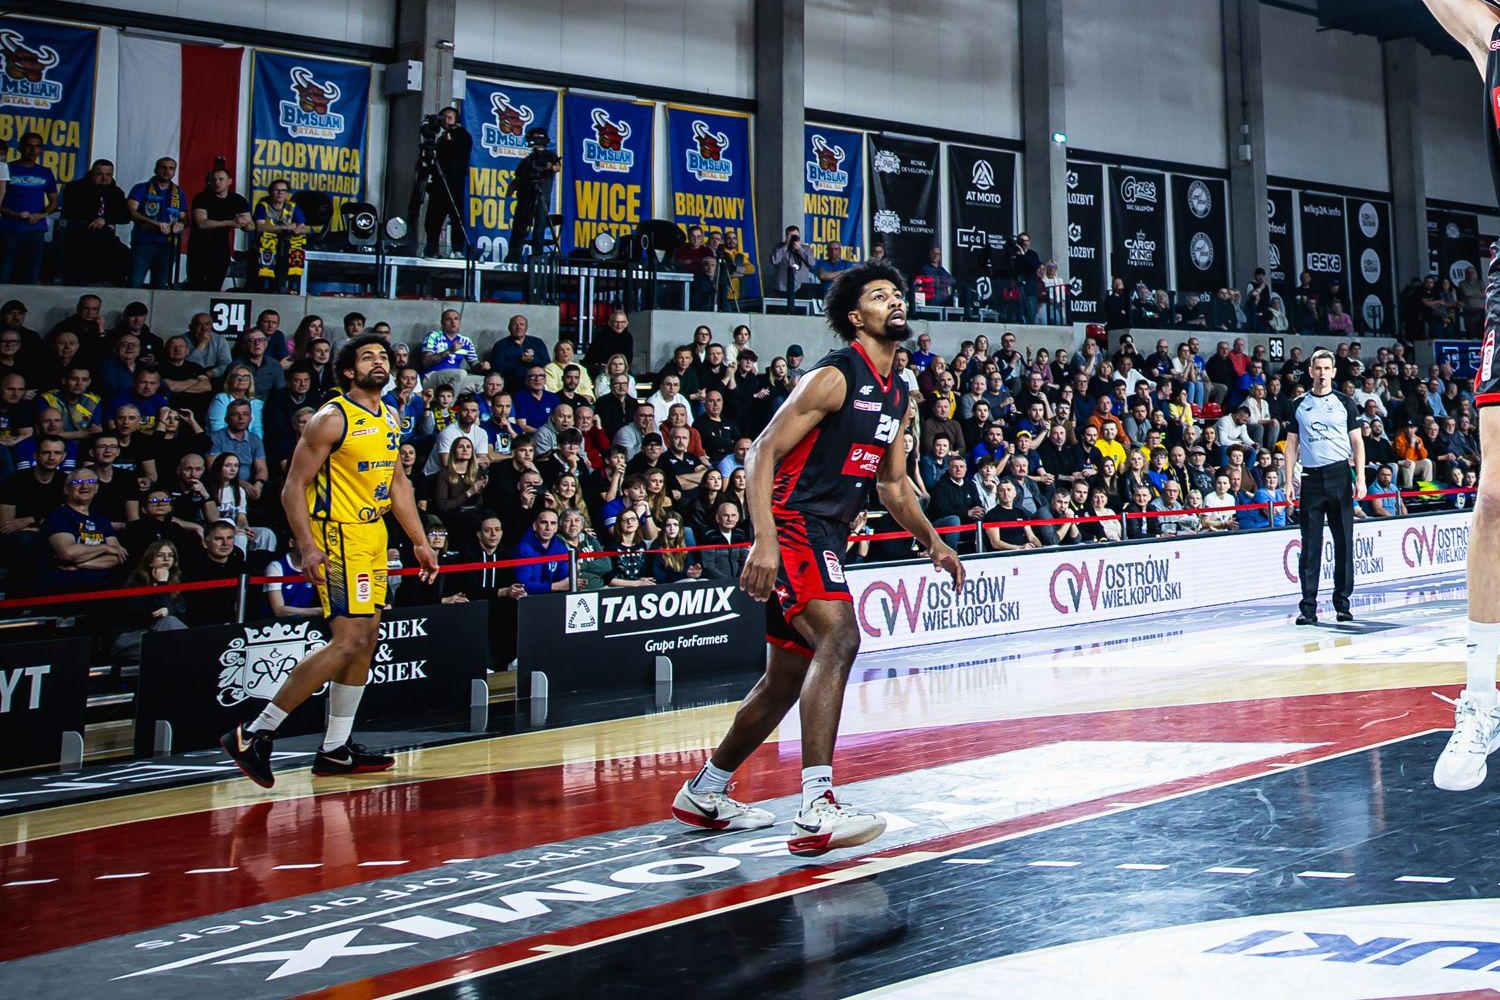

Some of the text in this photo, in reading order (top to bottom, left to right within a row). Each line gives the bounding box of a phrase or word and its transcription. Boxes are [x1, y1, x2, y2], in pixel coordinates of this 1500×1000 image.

[0, 76, 59, 99] MSLAM
[282, 103, 342, 129] BMSLAM
[0, 113, 80, 148] BYWCA
[485, 126, 529, 148] BMSLA
[253, 138, 361, 174] ZDOBYWCA
[585, 142, 633, 164] BMSLAM
[688, 152, 732, 174] BMSLAM
[808, 163, 848, 184] BMSLAM
[575, 179, 641, 223] WICE
[977, 192, 1001, 205] MOTO
[1067, 192, 1095, 207] LOZBYT
[1120, 175, 1158, 203] Grześ
[674, 191, 745, 225] BRĄZOWY
[803, 192, 850, 219] MISTRZ
[812, 216, 842, 243] LIGI
[1067, 244, 1096, 260] LOZBYT
[1123, 238, 1156, 252] CARGO
[211, 302, 247, 333] 34
[1070, 299, 1097, 313] LOZBYT
[1269, 338, 1284, 359] 36
[1438, 520, 1470, 549] OSTRÓ
[1104, 554, 1170, 590] OSTRÓW
[601, 585, 736, 624] TASOMIX
[1101, 581, 1183, 609] WIELKOPOLSKI
[376, 618, 430, 641] SIEK
[921, 600, 1021, 632] WIELKOPOLSKI
[374, 645, 394, 664] &
[645, 633, 729, 654] Grupa ForFarmers
[364, 660, 428, 687] OSIEK
[134, 833, 669, 950] Grupa ForFarmers
[211, 834, 798, 982] SOMIX
